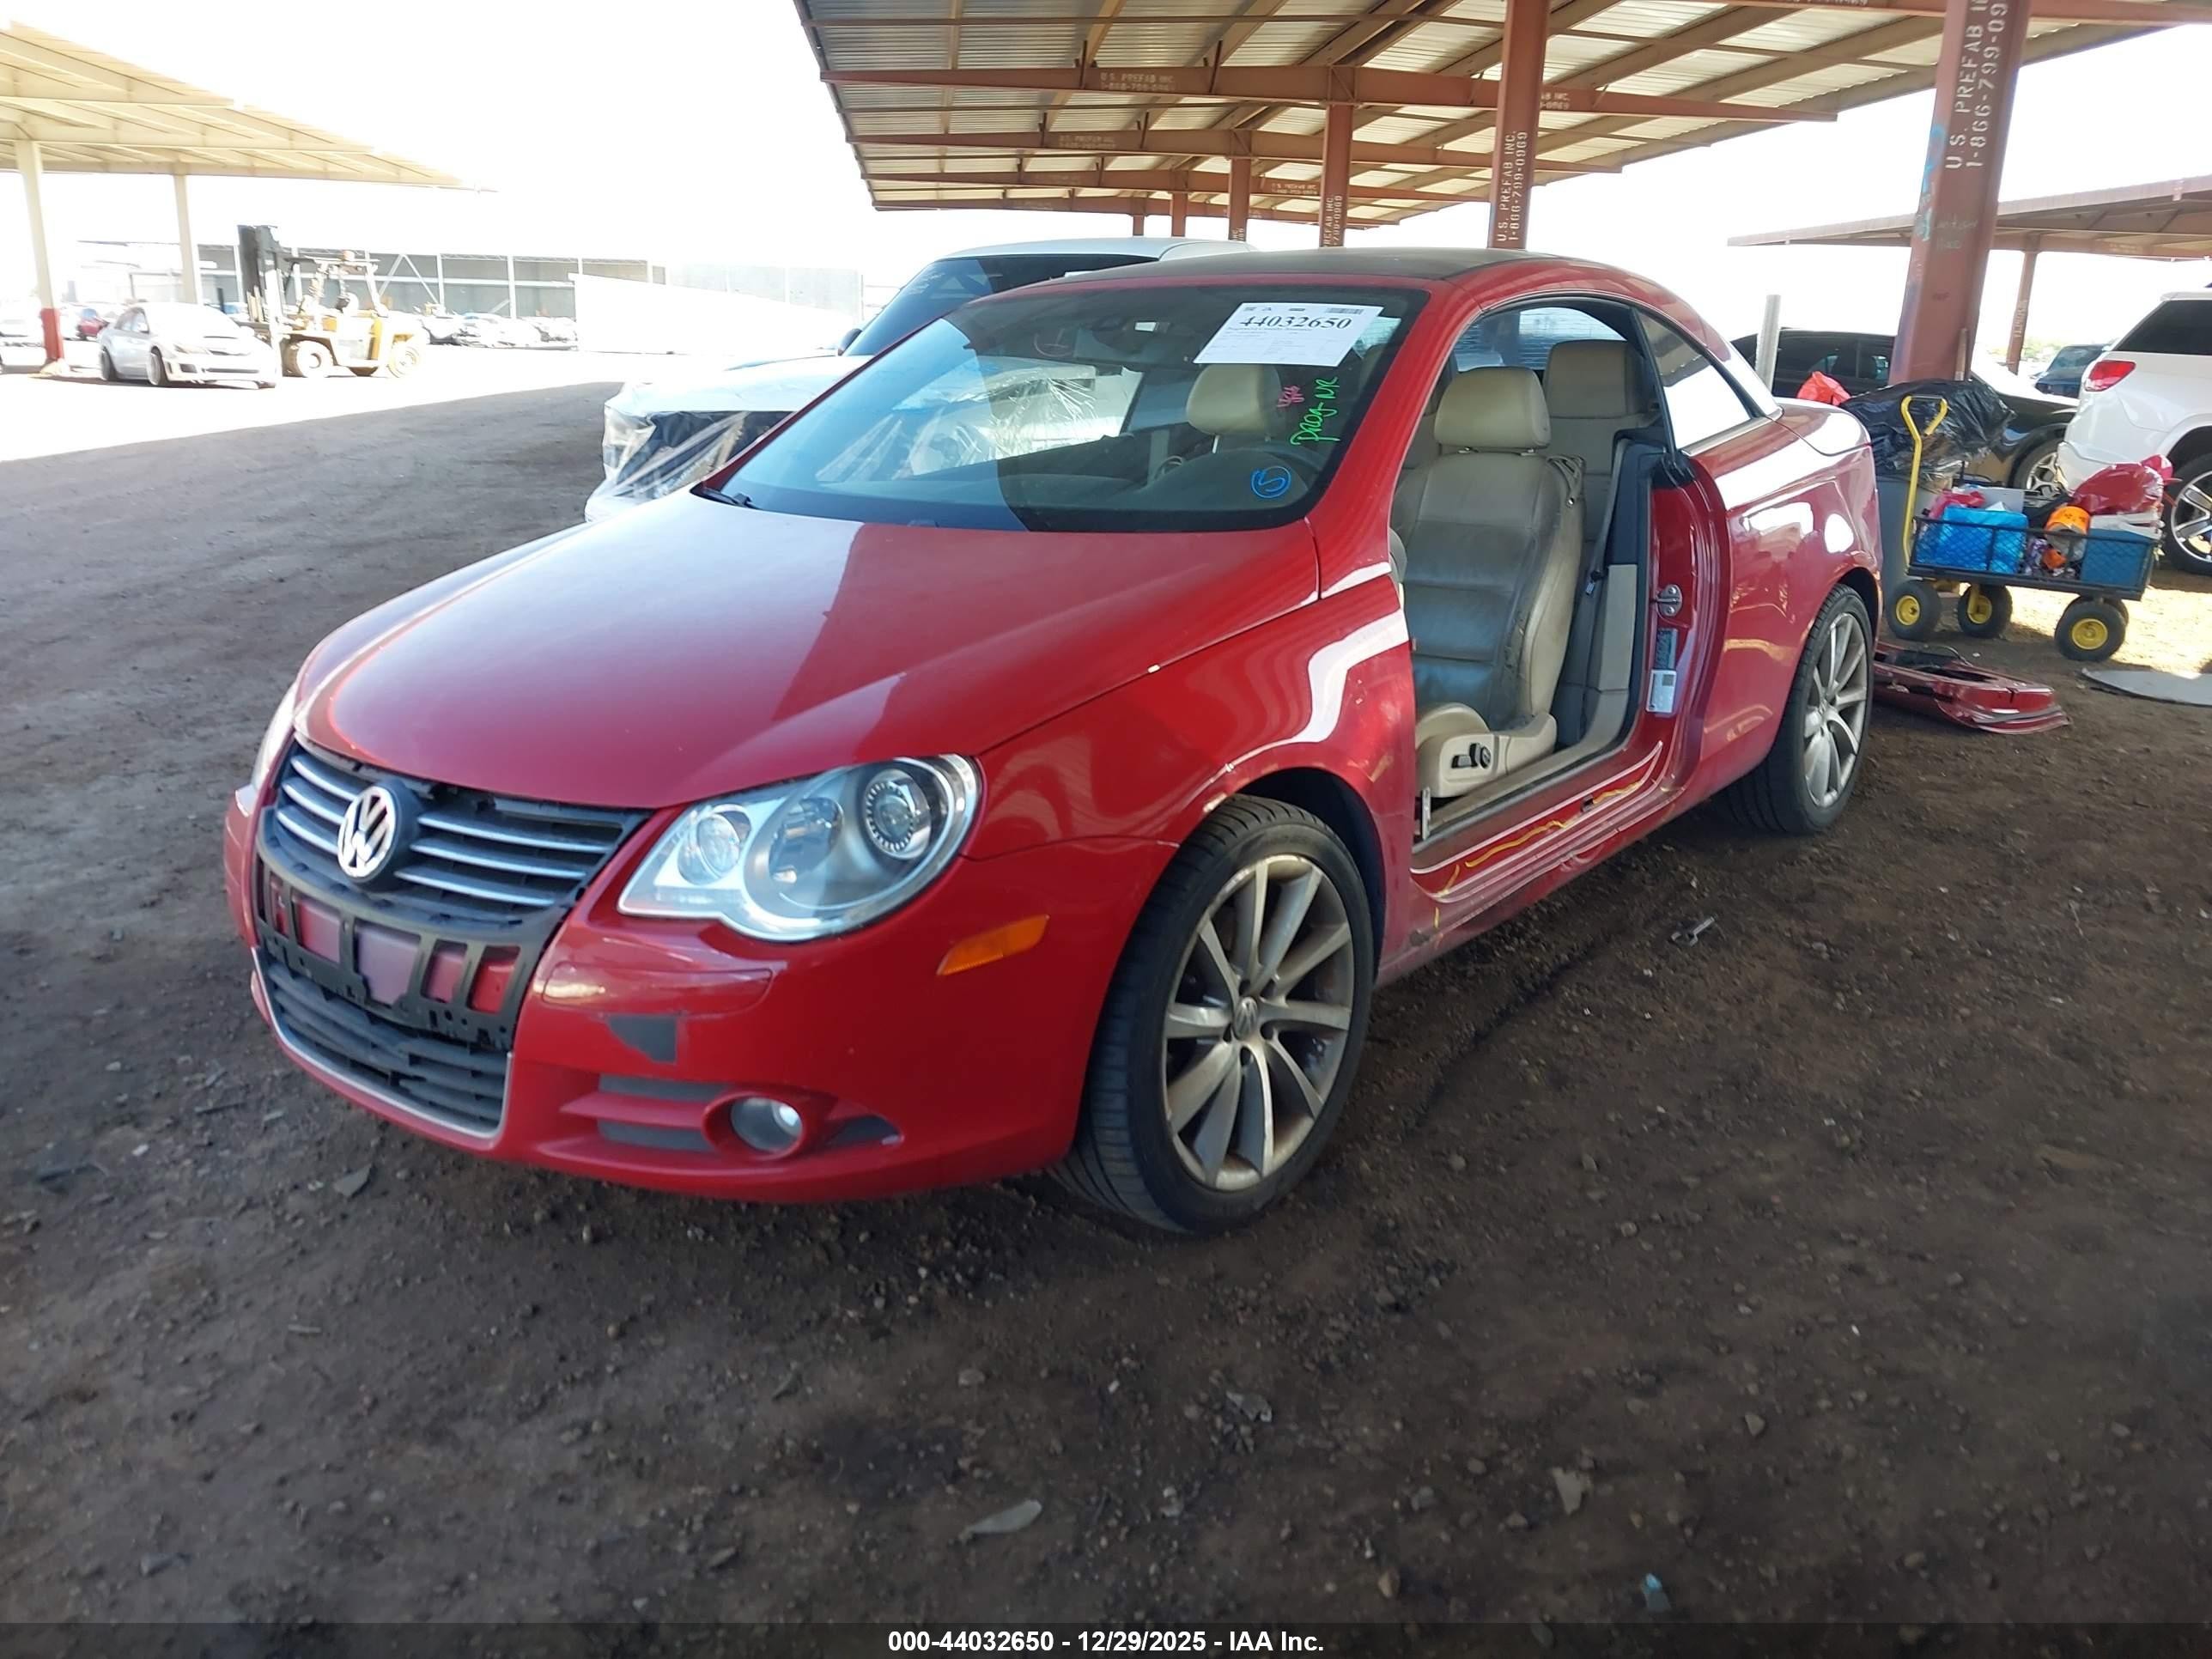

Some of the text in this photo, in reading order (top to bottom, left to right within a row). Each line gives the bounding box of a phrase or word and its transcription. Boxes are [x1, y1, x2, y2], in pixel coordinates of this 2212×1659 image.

[1954, 25, 1984, 112] PREFAB
[1497, 131, 1516, 241] U.S. PREFAB INC.
[1508, 131, 1528, 240] 1-866-799-0969
[1323, 216, 1334, 247] REFAB
[1240, 315, 1352, 329] 44032650
